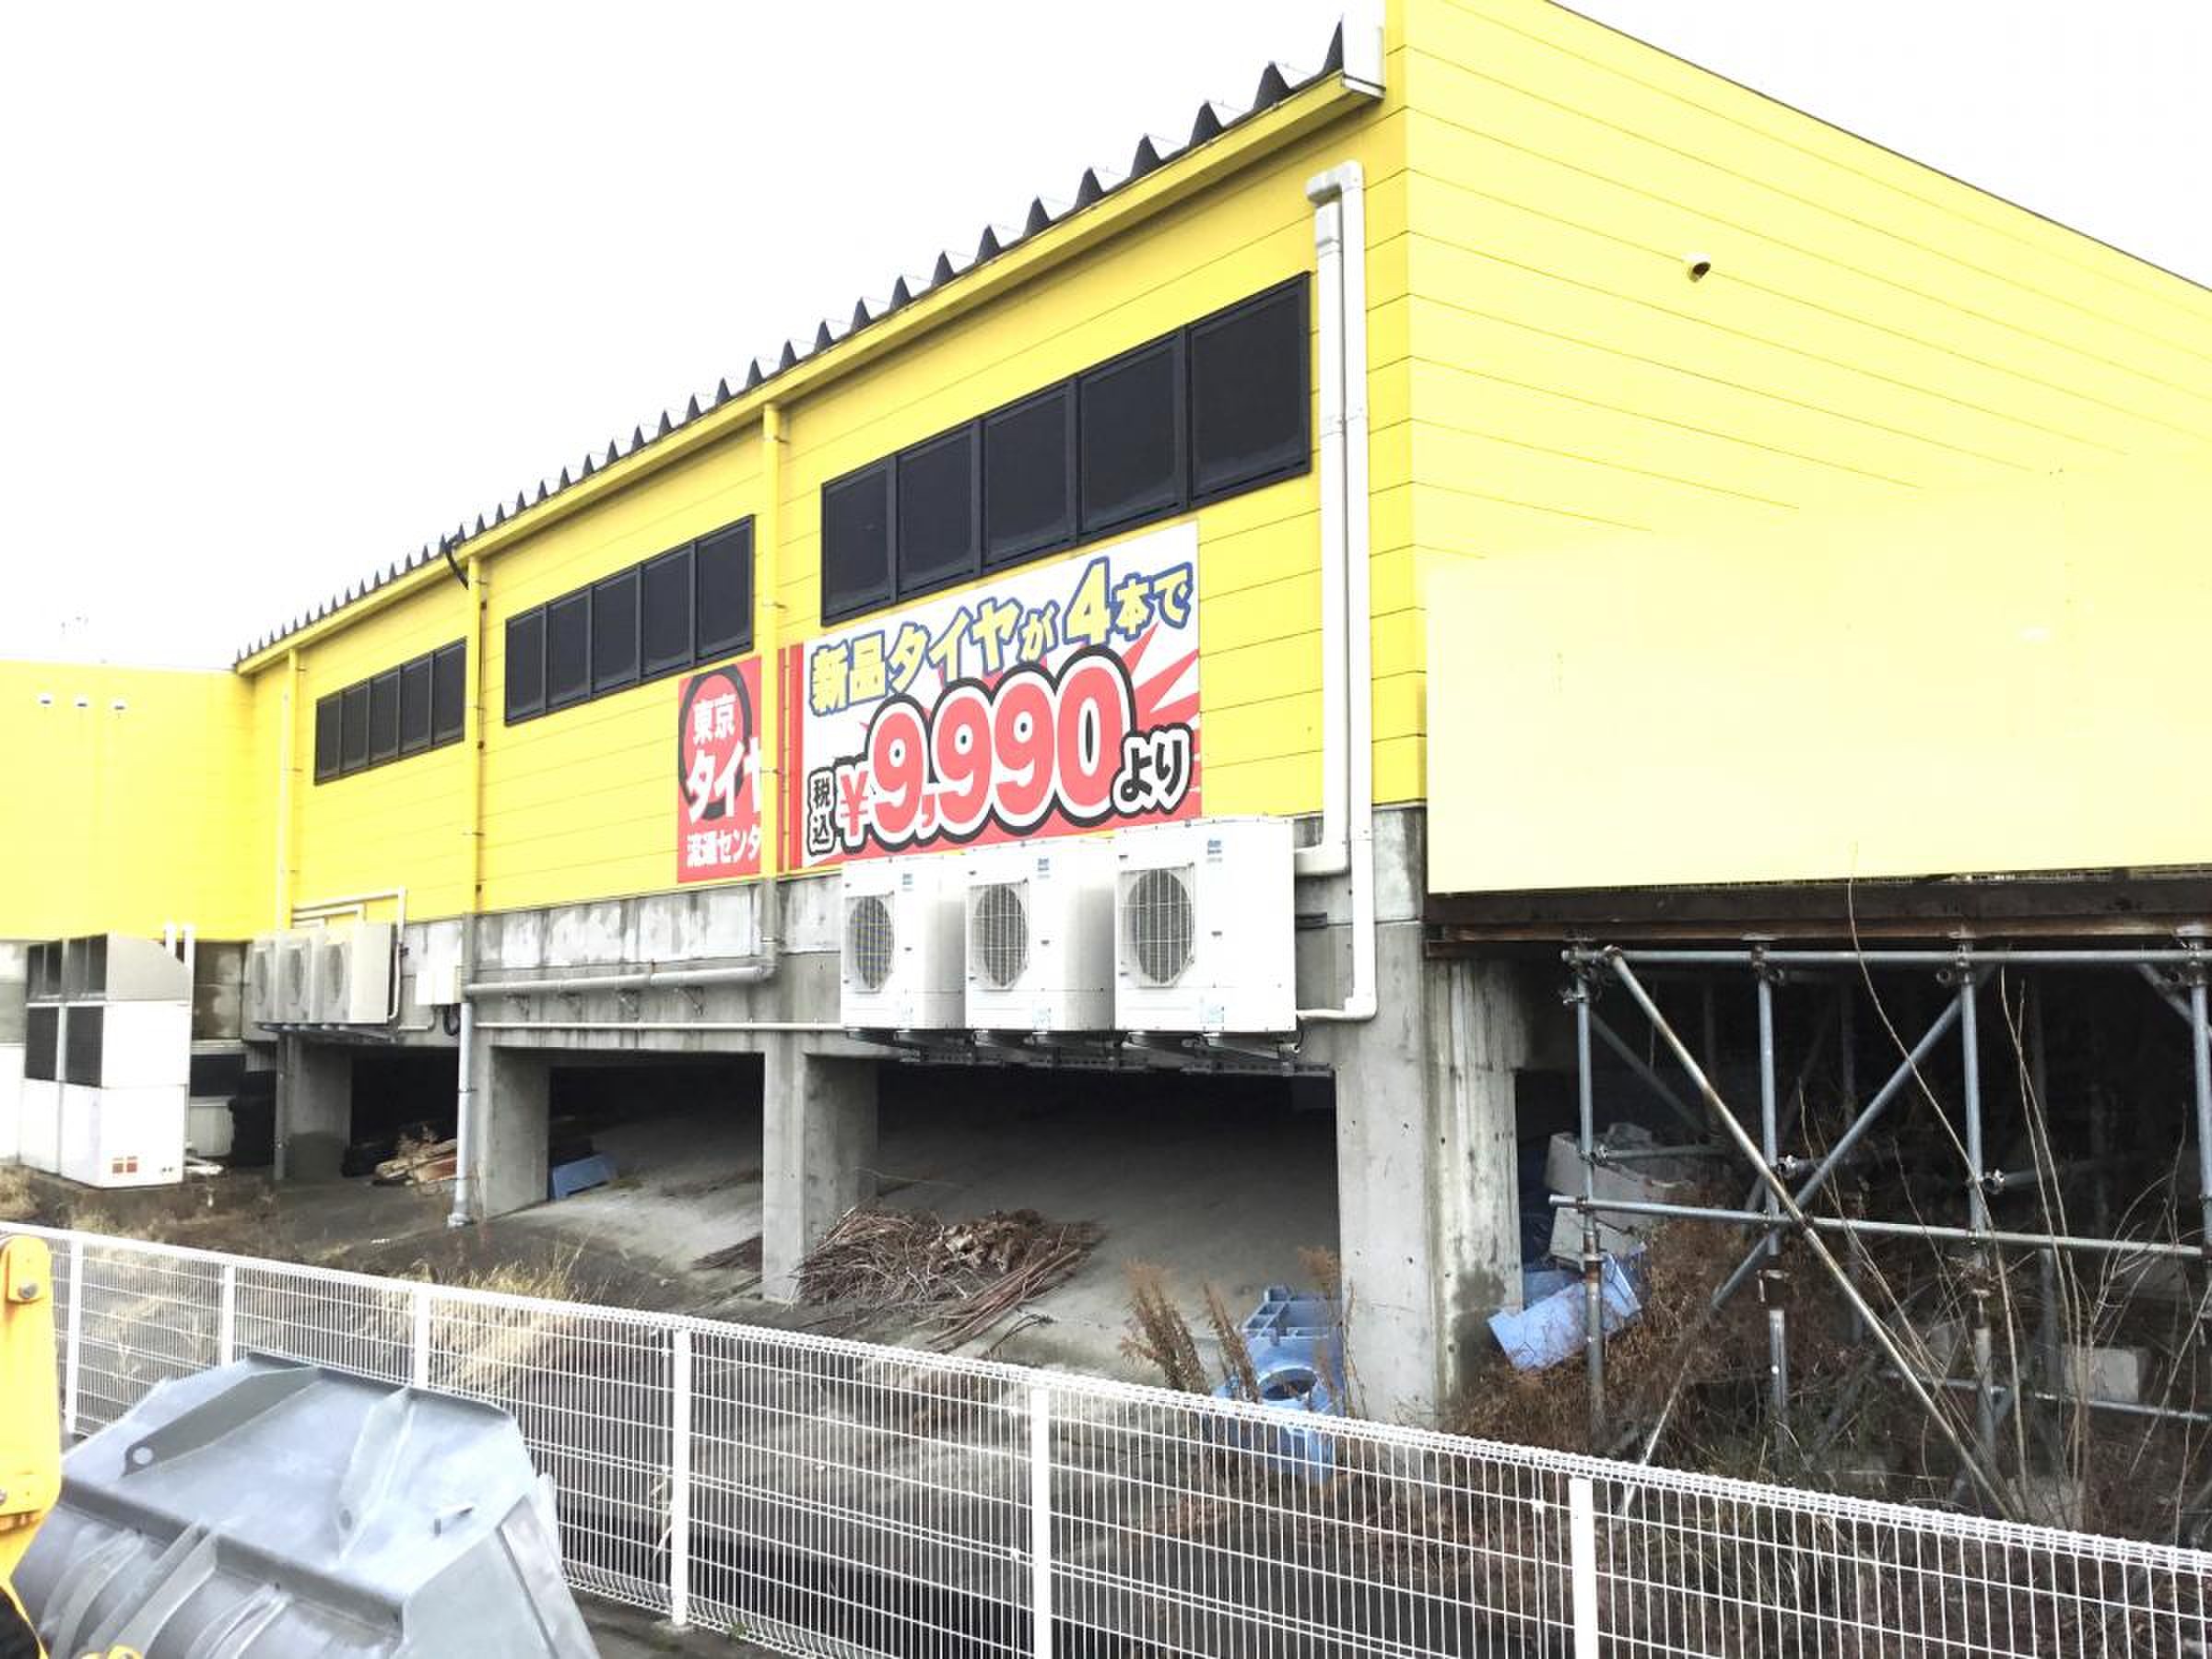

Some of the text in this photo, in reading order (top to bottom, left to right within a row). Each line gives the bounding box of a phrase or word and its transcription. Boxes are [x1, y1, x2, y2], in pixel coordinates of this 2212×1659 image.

[810, 556, 1194, 717] 新品タイヤが4本で
[693, 693, 736, 744] 東京
[811, 772, 833, 852] 税込
